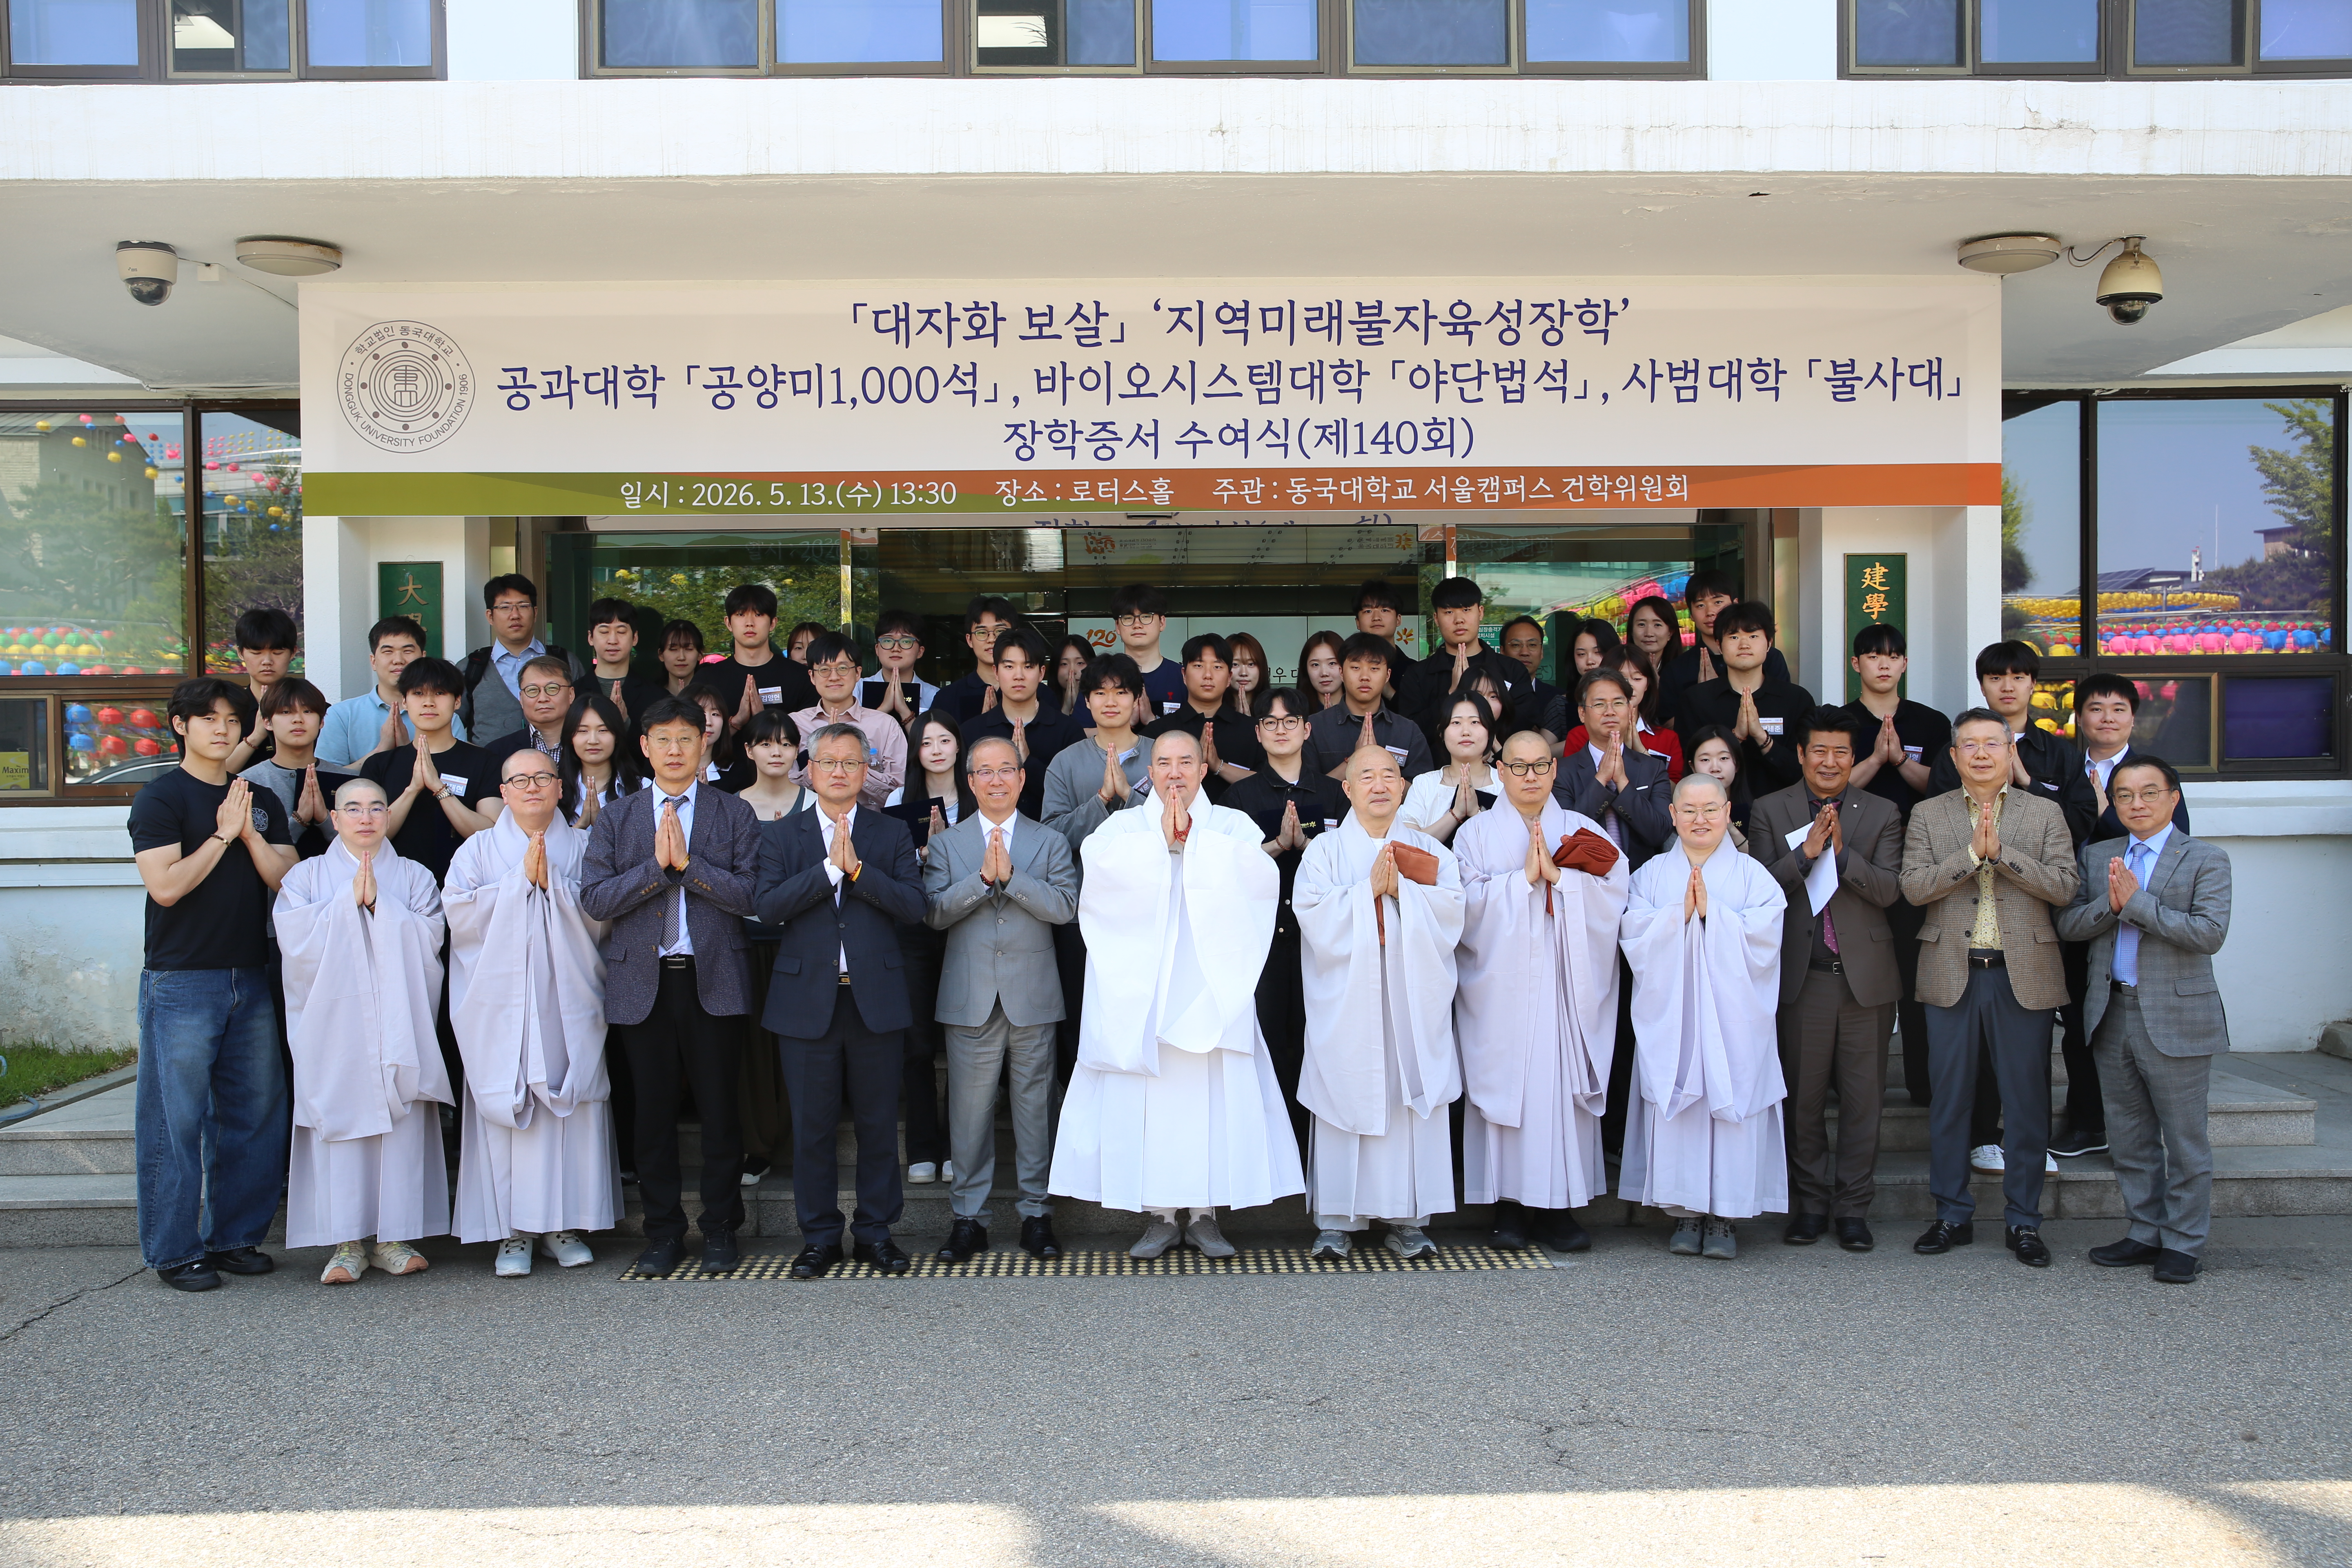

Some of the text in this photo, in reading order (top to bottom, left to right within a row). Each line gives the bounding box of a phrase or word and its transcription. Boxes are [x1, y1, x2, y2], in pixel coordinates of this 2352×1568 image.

[355, 325, 454, 357] 학교법인 동국대학교
[854, 301, 1006, 347] 「대자화
[1020, 301, 1124, 347] 보살」
[498, 365, 665, 410] 공과대학
[1035, 359, 1370, 406] 바이오시스템대학
[1623, 358, 1786, 402] 사범대학
[1810, 358, 1960, 401] 「불사대」
[344, 372, 468, 447] DONGGUK UNIVERSITY FOUNDATION 1906
[1004, 417, 1473, 461] 장학증서 수여식(제140회)
[693, 483, 761, 506] 2026.
[770, 483, 791, 506] 5.
[800, 480, 881, 508] 13.(수)
[891, 482, 956, 504] 13:30
[1069, 477, 1174, 505] 로터스홀
[1286, 476, 1417, 504] 동국대학교
[1424, 475, 1554, 503] 서울캠퍼스
[1562, 474, 1687, 502] 건학위원회
[1860, 562, 1890, 625] 建學
[2, 765, 29, 773] Maxim
